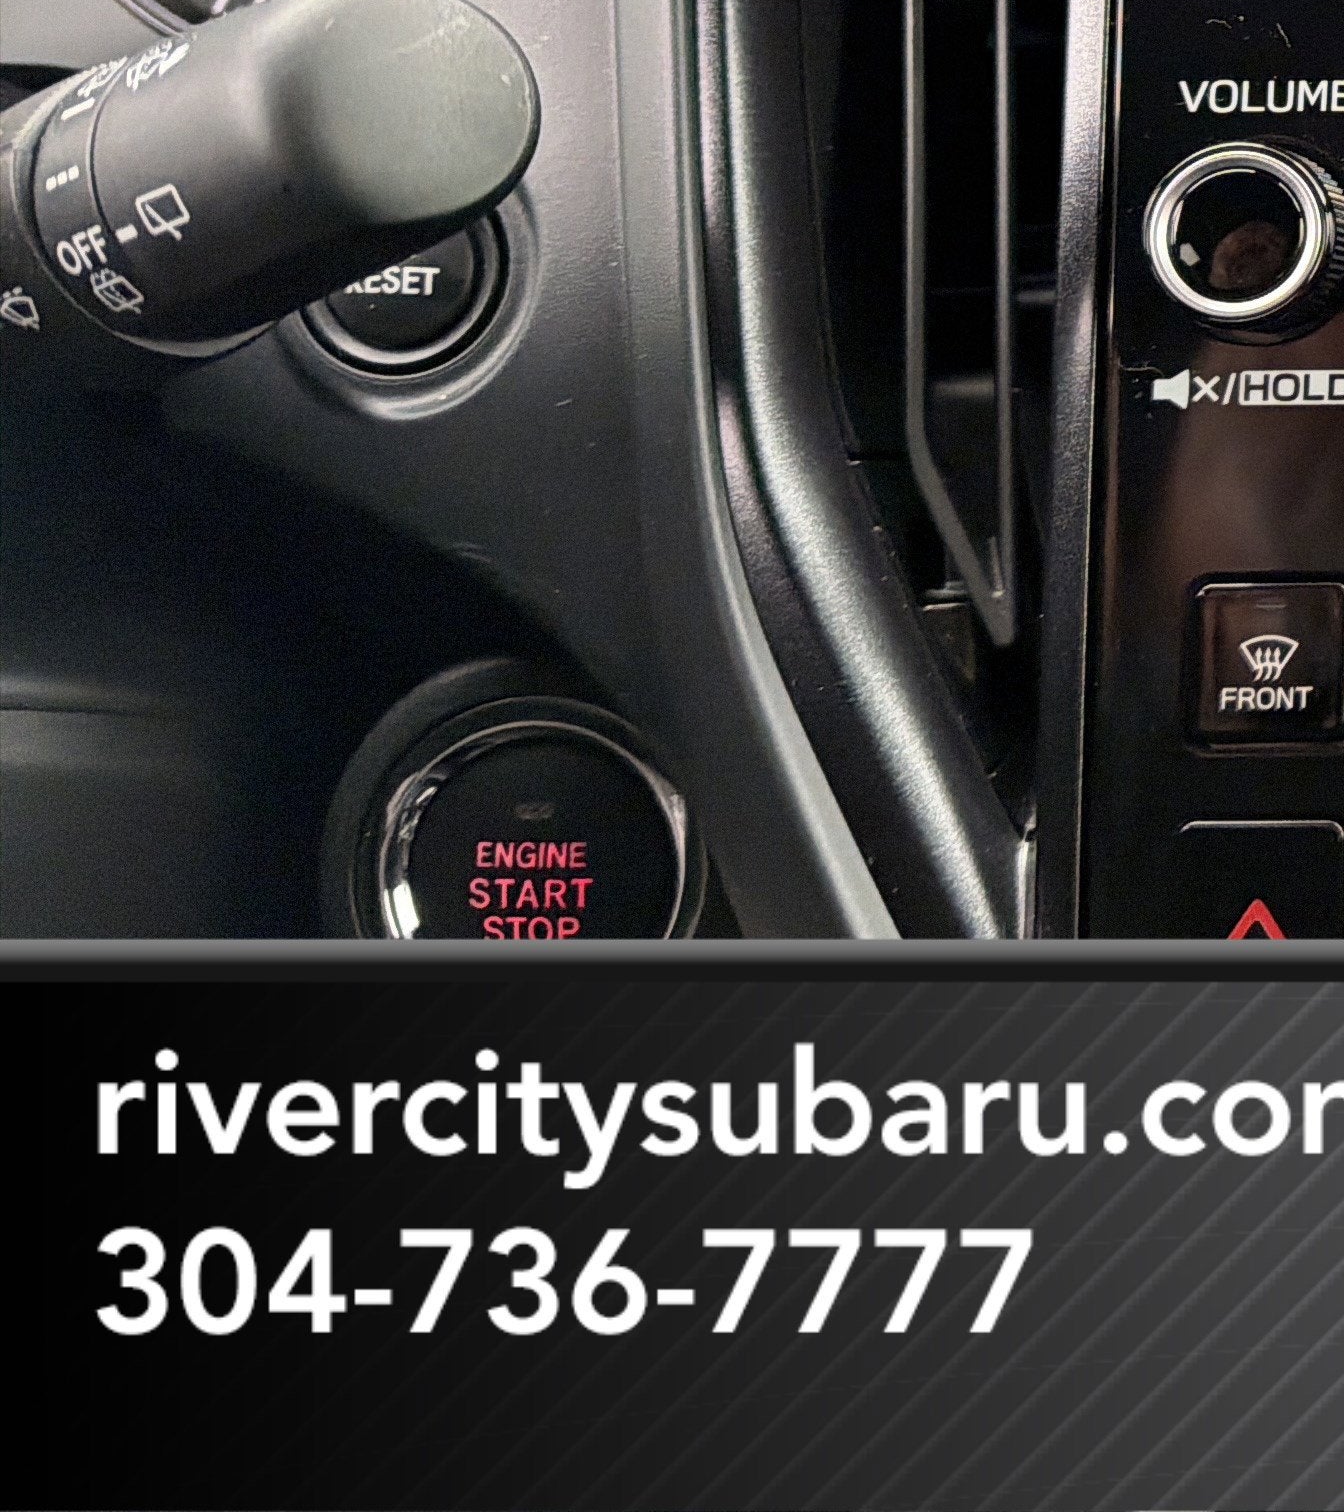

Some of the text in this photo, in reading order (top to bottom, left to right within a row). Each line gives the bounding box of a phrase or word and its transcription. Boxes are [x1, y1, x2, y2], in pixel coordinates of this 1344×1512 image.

[55, 224, 108, 278] OFF
[1219, 685, 1314, 711] FRONT
[476, 841, 586, 869] ENGINE
[469, 877, 594, 910] START
[483, 915, 580, 939] STOP
